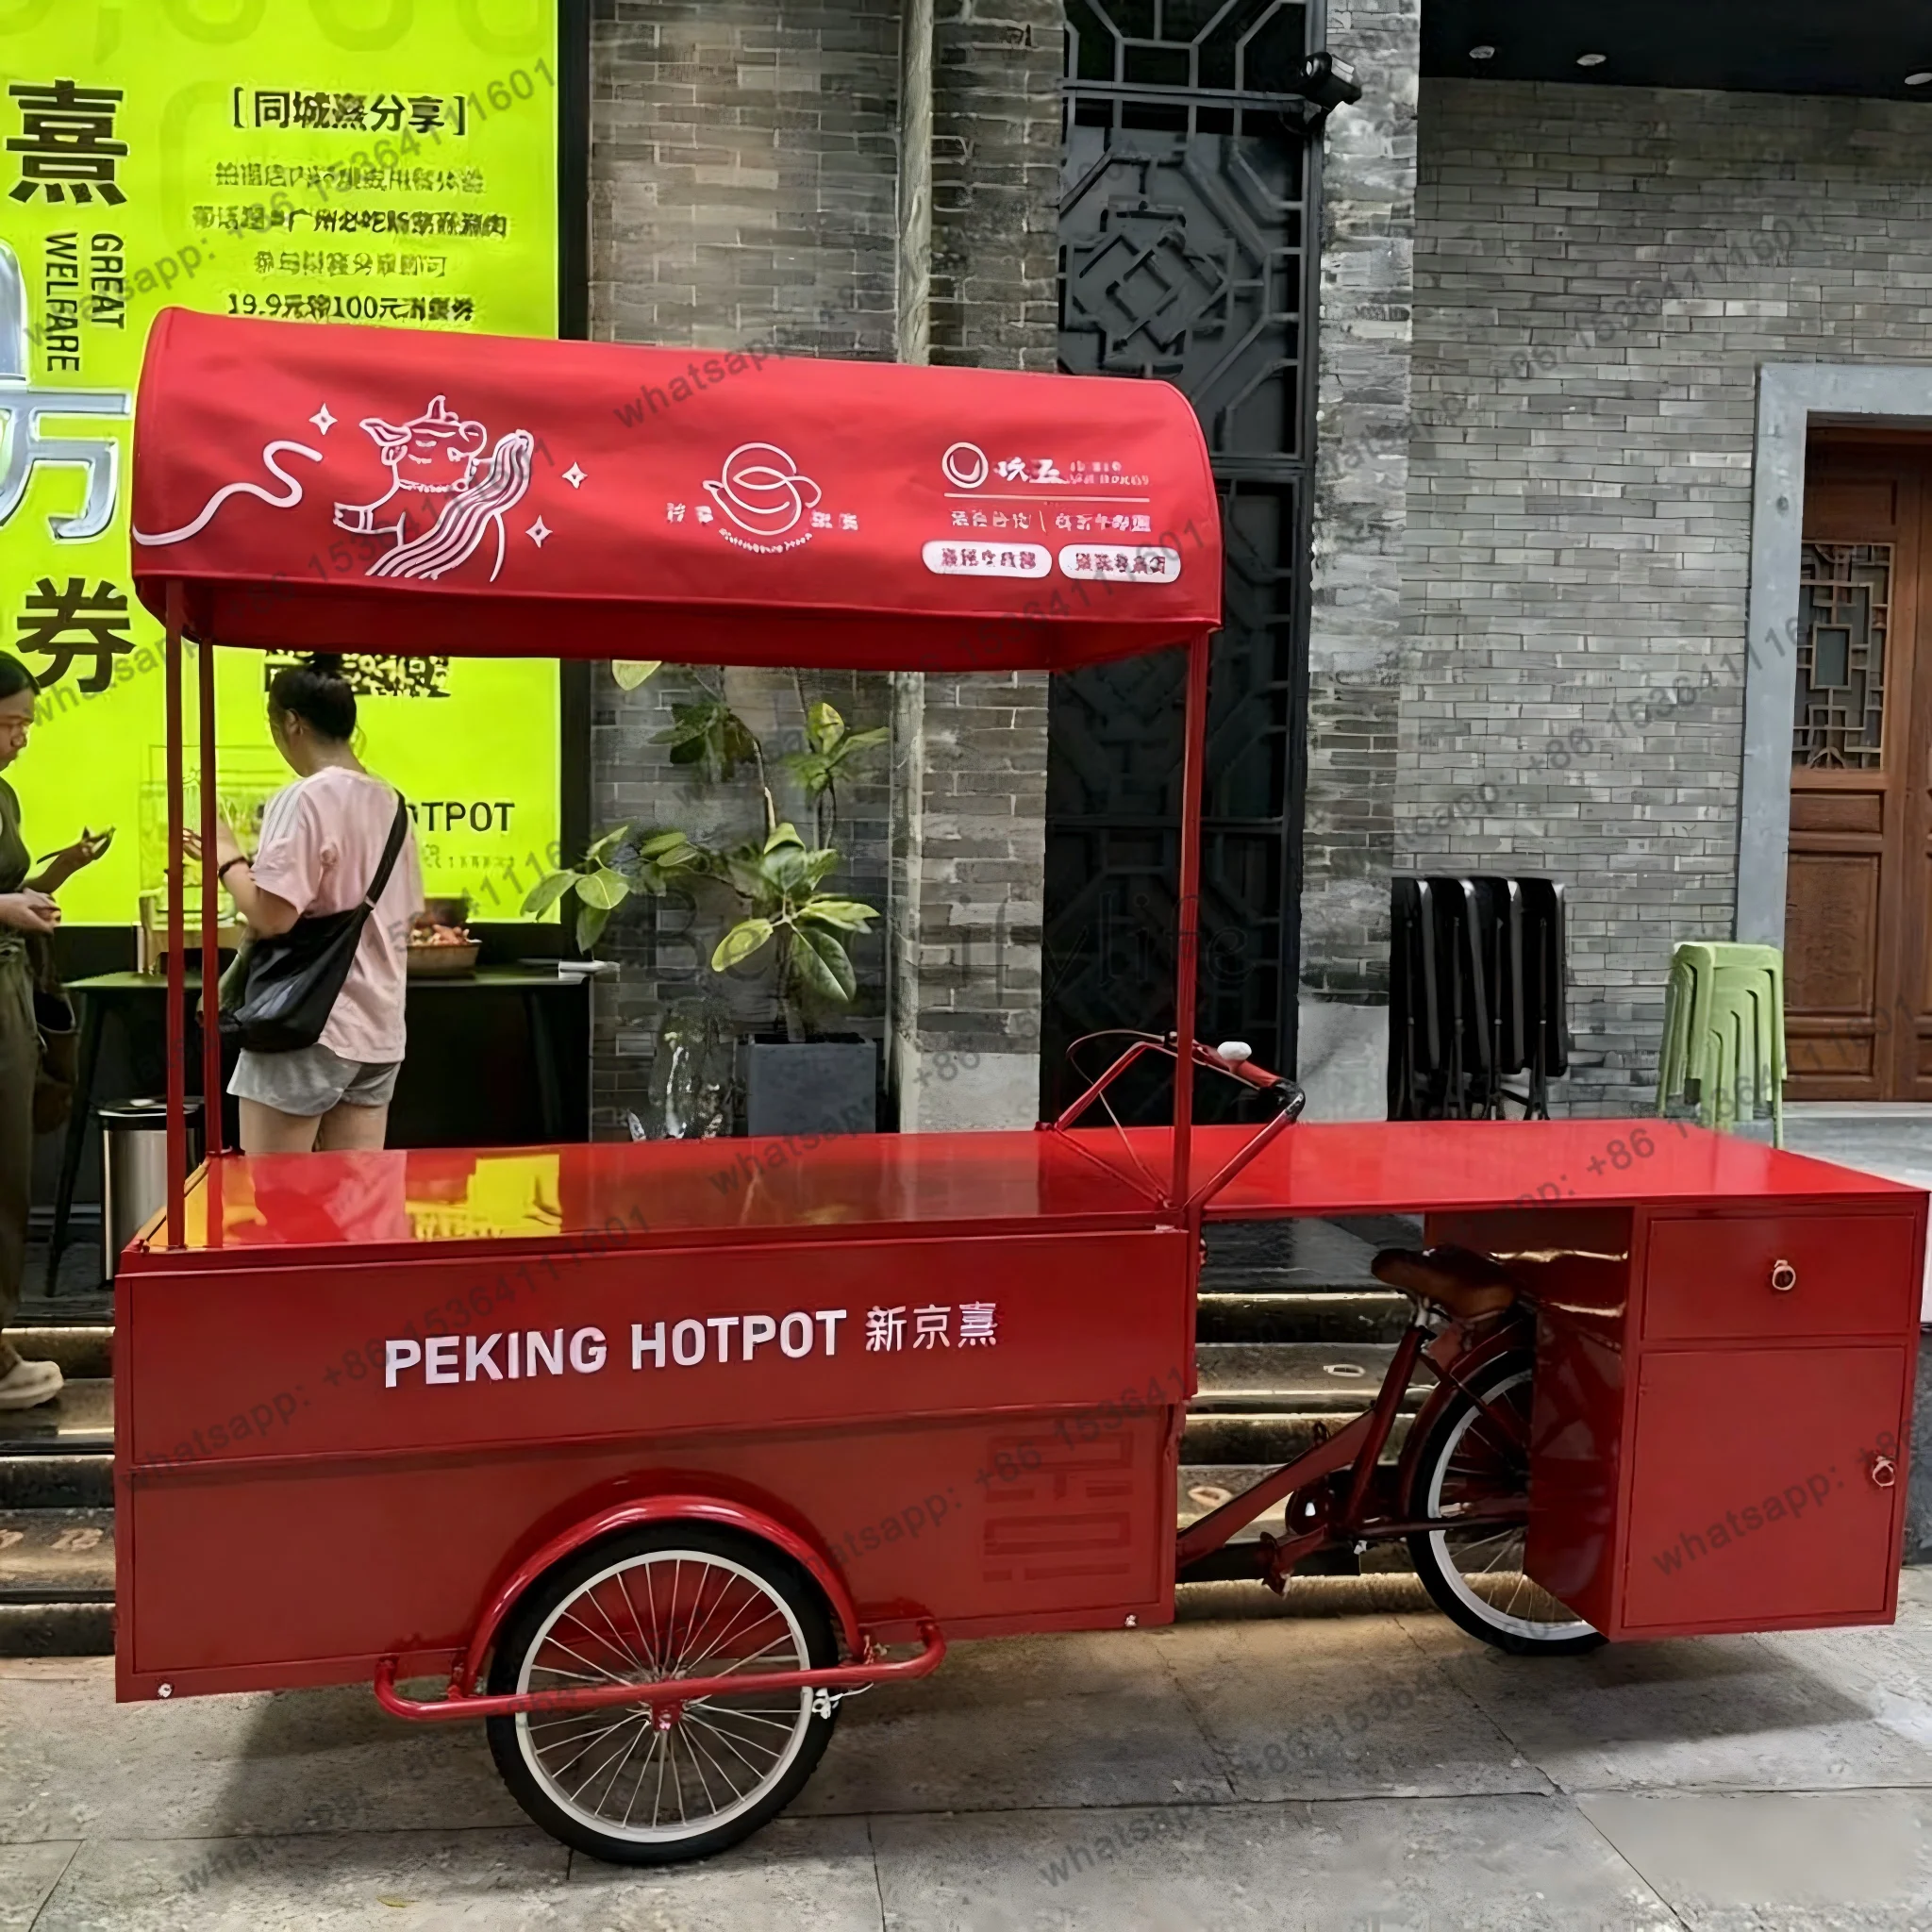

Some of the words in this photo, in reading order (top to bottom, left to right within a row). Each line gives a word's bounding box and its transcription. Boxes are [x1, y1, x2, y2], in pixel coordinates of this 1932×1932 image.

[45, 232, 79, 373] WELFARE
[92, 232, 125, 330] GREAT
[16, 577, 137, 693] 券
[406, 802, 515, 831] TPOT
[384, 1325, 608, 1389] PEKING
[630, 1309, 847, 1372] HOTPOT
[865, 1301, 999, 1353] 新京熹
